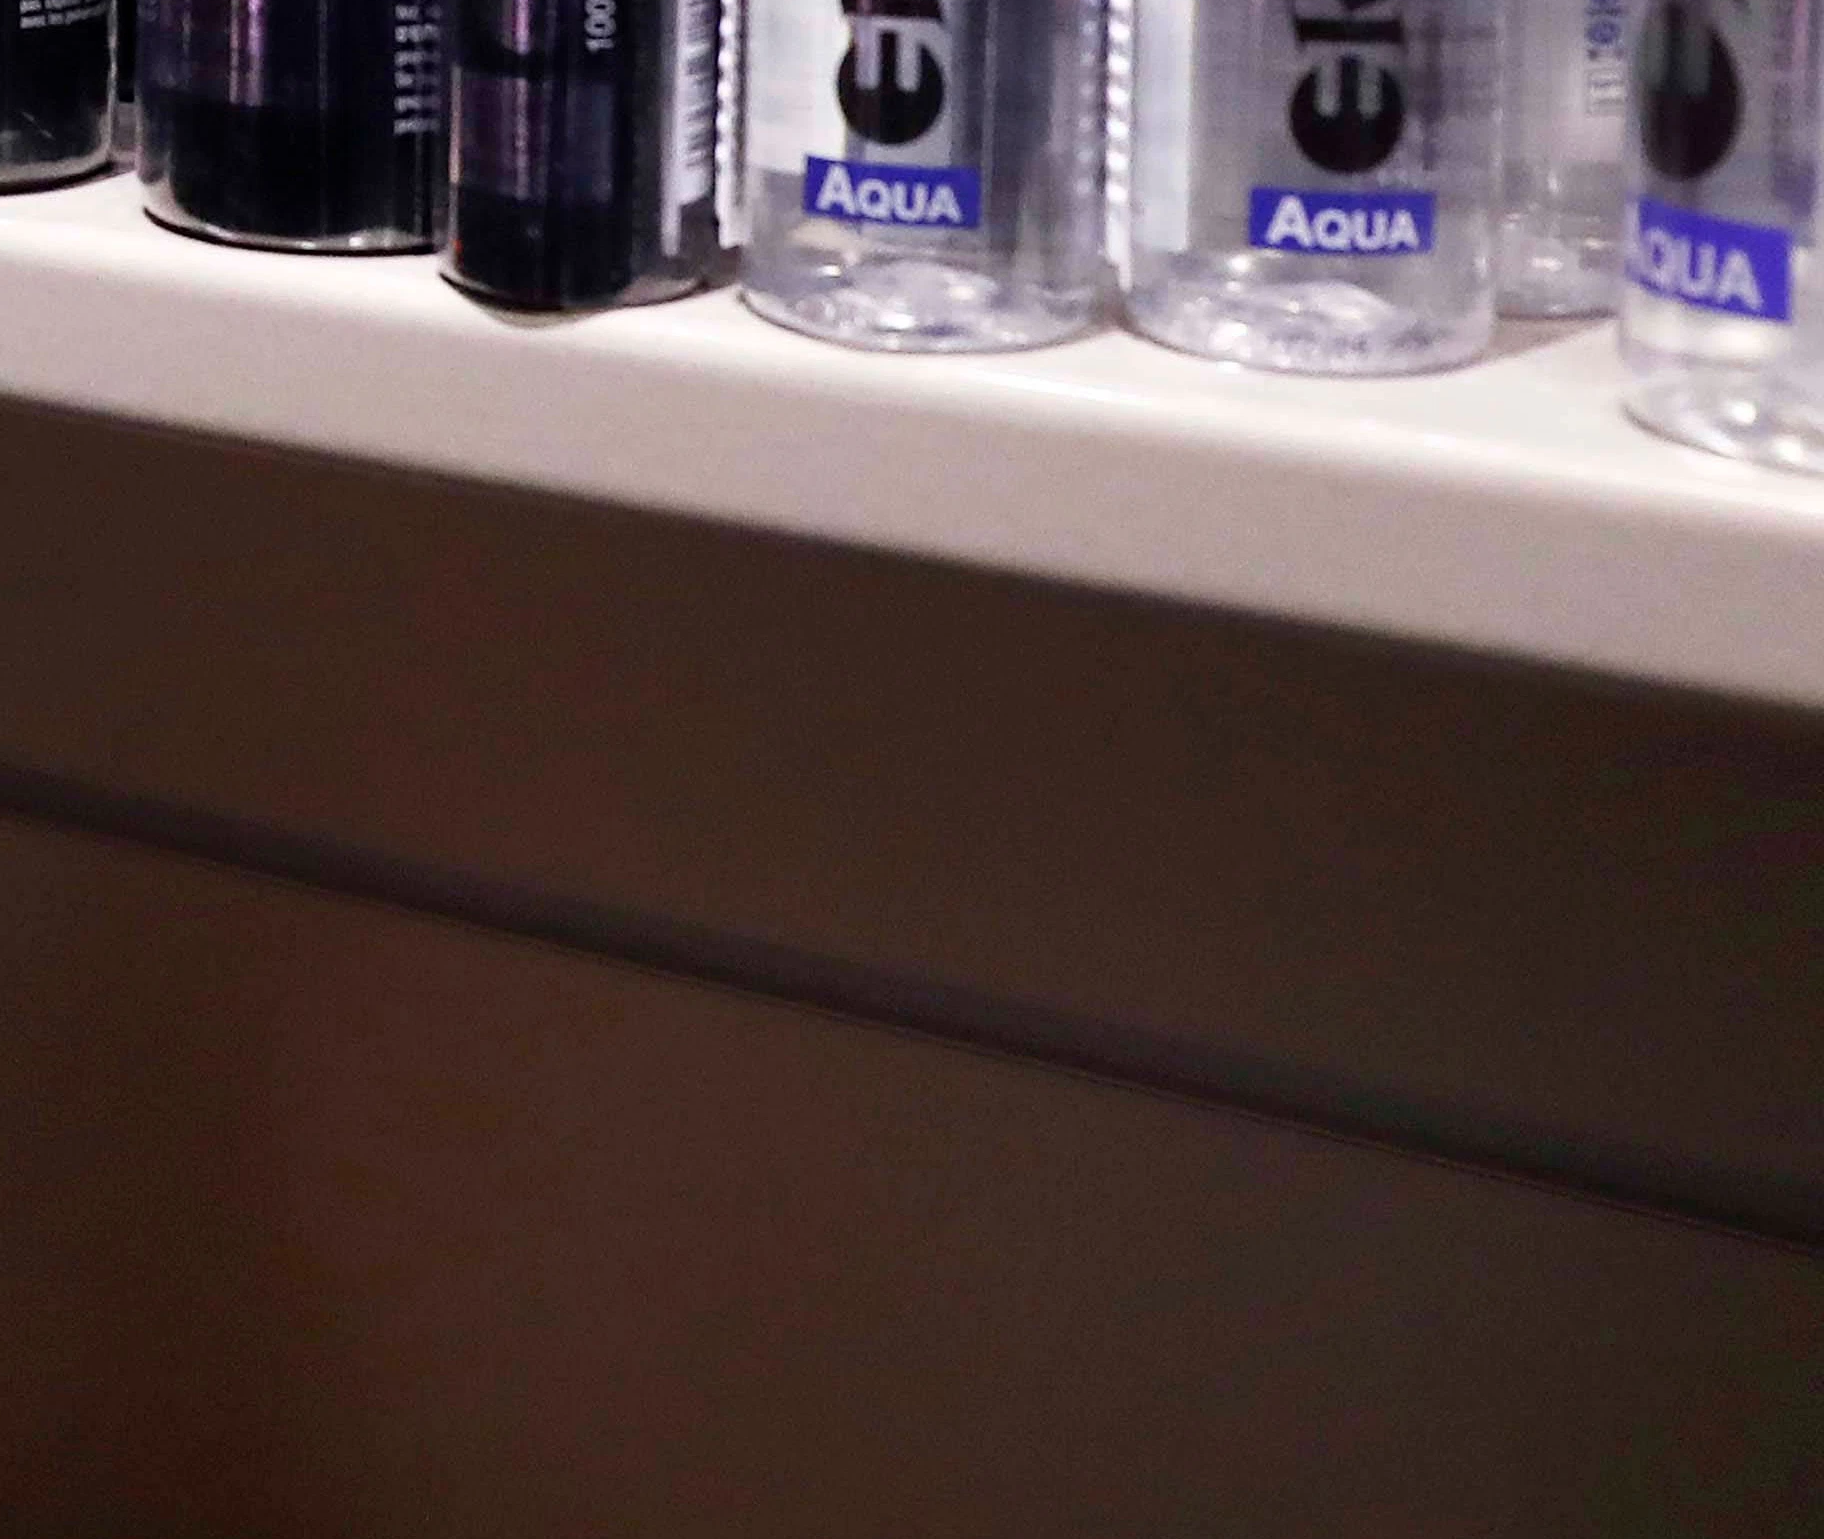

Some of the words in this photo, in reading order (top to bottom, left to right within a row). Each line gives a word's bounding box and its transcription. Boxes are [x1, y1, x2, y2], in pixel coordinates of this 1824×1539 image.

[815, 163, 963, 226] AQUA
[1264, 195, 1420, 253] AQUA
[1638, 225, 1763, 310] QUA
